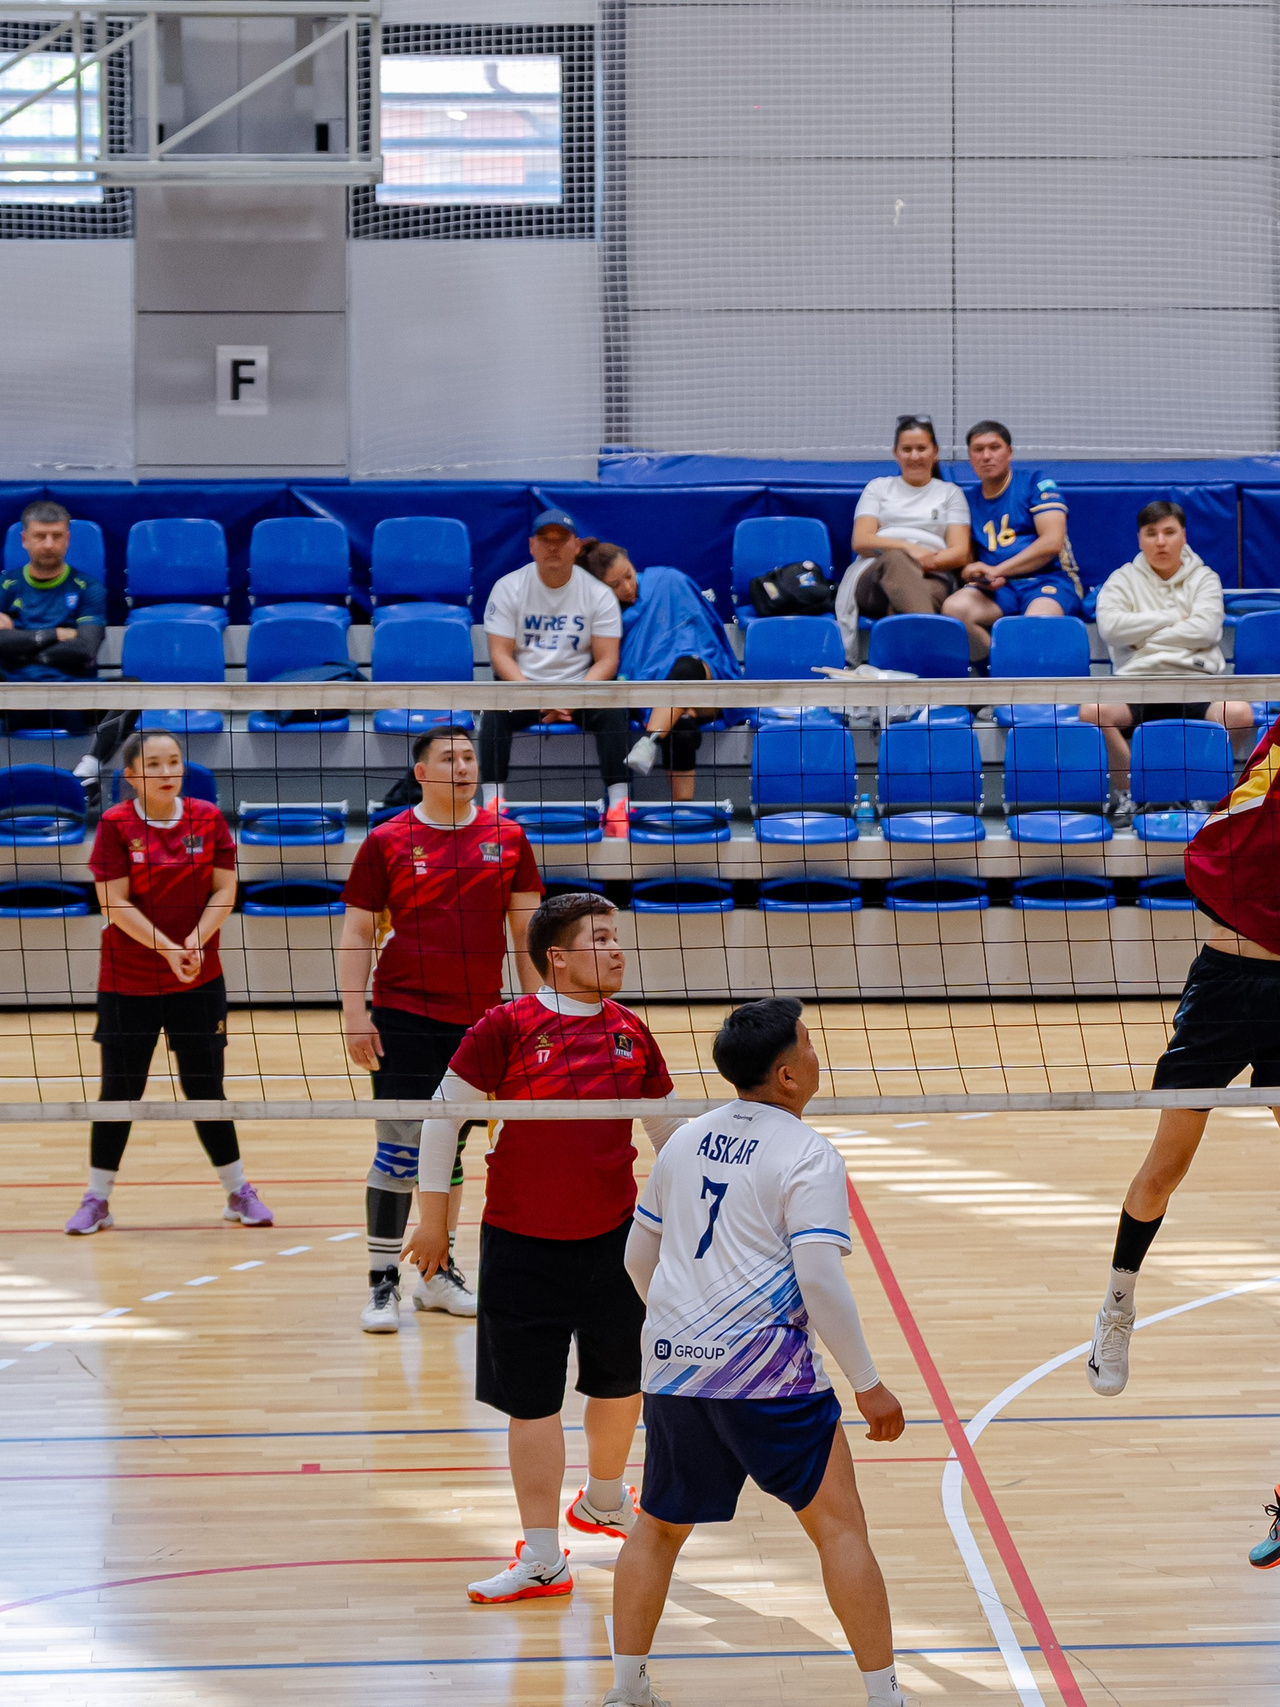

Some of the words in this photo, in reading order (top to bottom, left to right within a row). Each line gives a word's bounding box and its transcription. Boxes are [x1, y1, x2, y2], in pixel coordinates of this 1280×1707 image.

[231, 359, 256, 401] F
[983, 513, 1017, 552] 16
[536, 1049, 551, 1064] 17
[696, 1131, 760, 1165] ASKAR
[694, 1175, 729, 1260] 7
[656, 1341, 670, 1358] BI
[674, 1344, 726, 1360] GROUP
